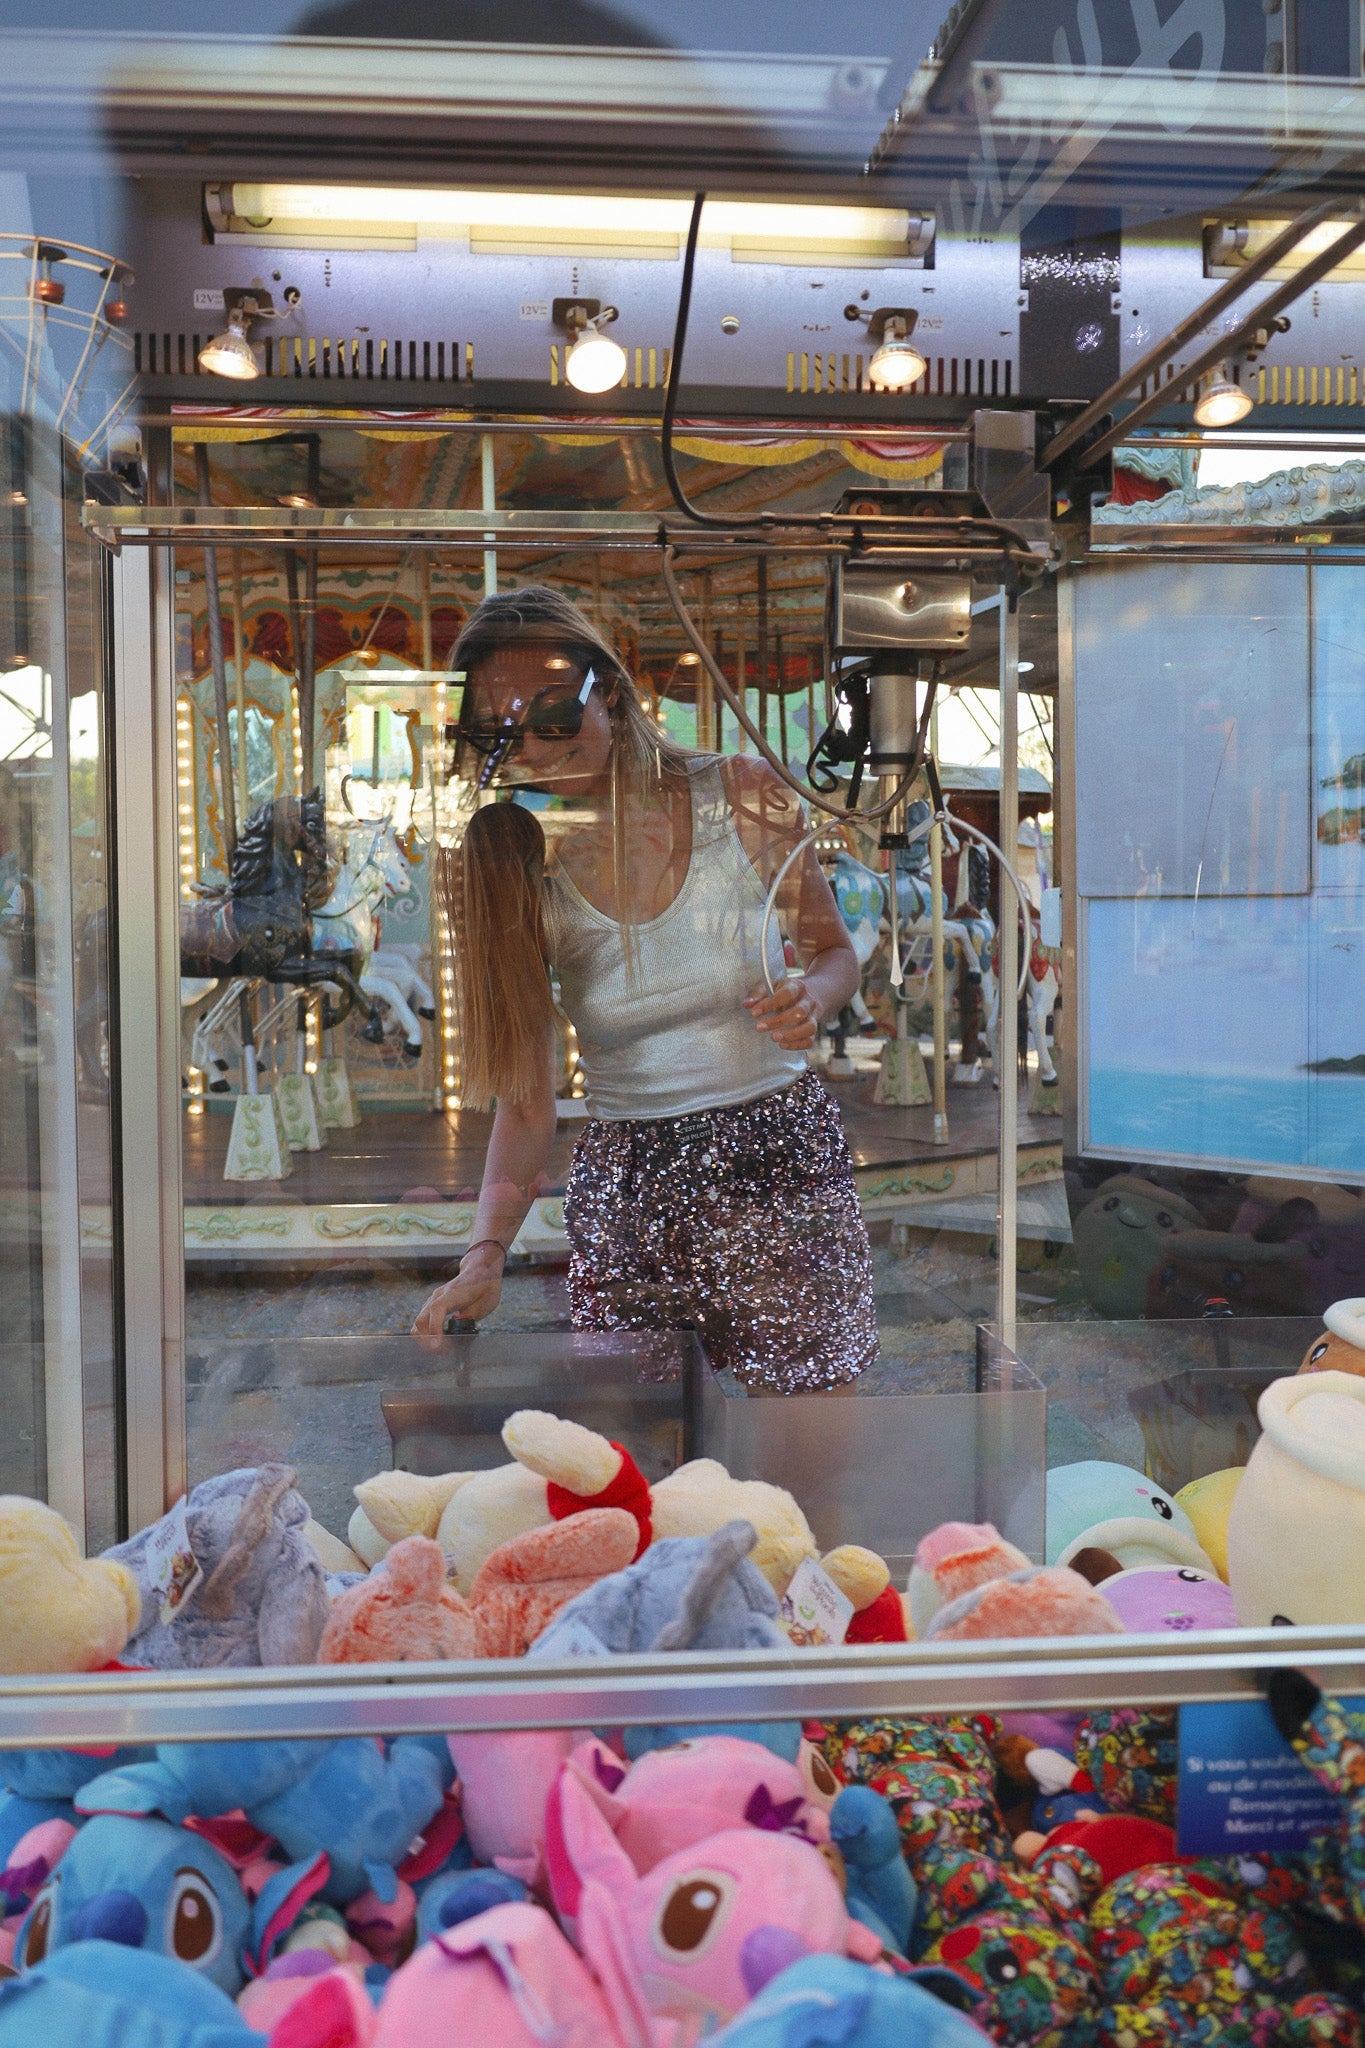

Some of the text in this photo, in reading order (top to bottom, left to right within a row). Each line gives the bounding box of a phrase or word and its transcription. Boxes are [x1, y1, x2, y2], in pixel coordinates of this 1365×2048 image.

[195, 293, 214, 303] 12V
[521, 305, 540, 315] 12V
[1206, 1759, 1248, 1772] vous
[1224, 1818, 1275, 1834] Merci
[1276, 1819, 1295, 1832] et
